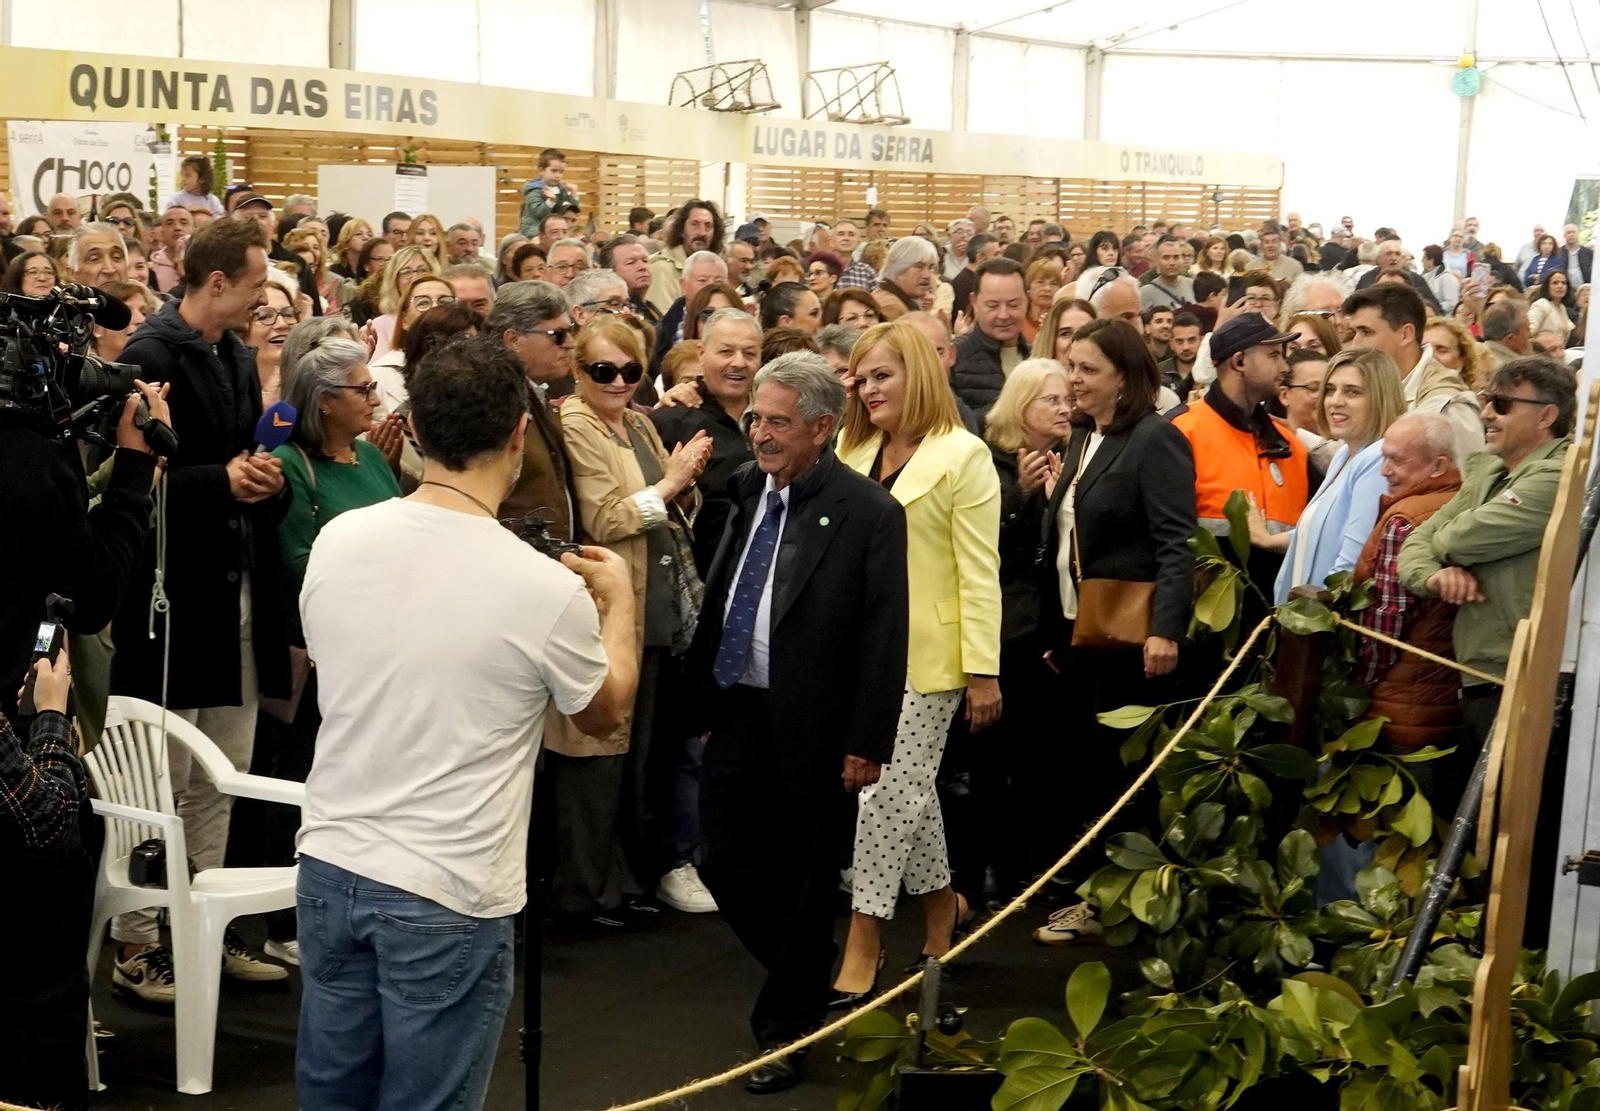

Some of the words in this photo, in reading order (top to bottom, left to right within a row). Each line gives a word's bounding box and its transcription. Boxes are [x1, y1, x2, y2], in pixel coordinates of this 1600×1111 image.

[69, 63, 234, 113] QUINTA
[250, 76, 329, 118] DAS
[344, 82, 439, 126] EIRAS
[753, 124, 827, 159] LUGAR
[834, 130, 862, 161] DA
[871, 133, 934, 164] SERRA
[1120, 149, 1130, 173] O
[1135, 151, 1204, 177] TRANQUILO
[33, 157, 132, 216] CHOCO
